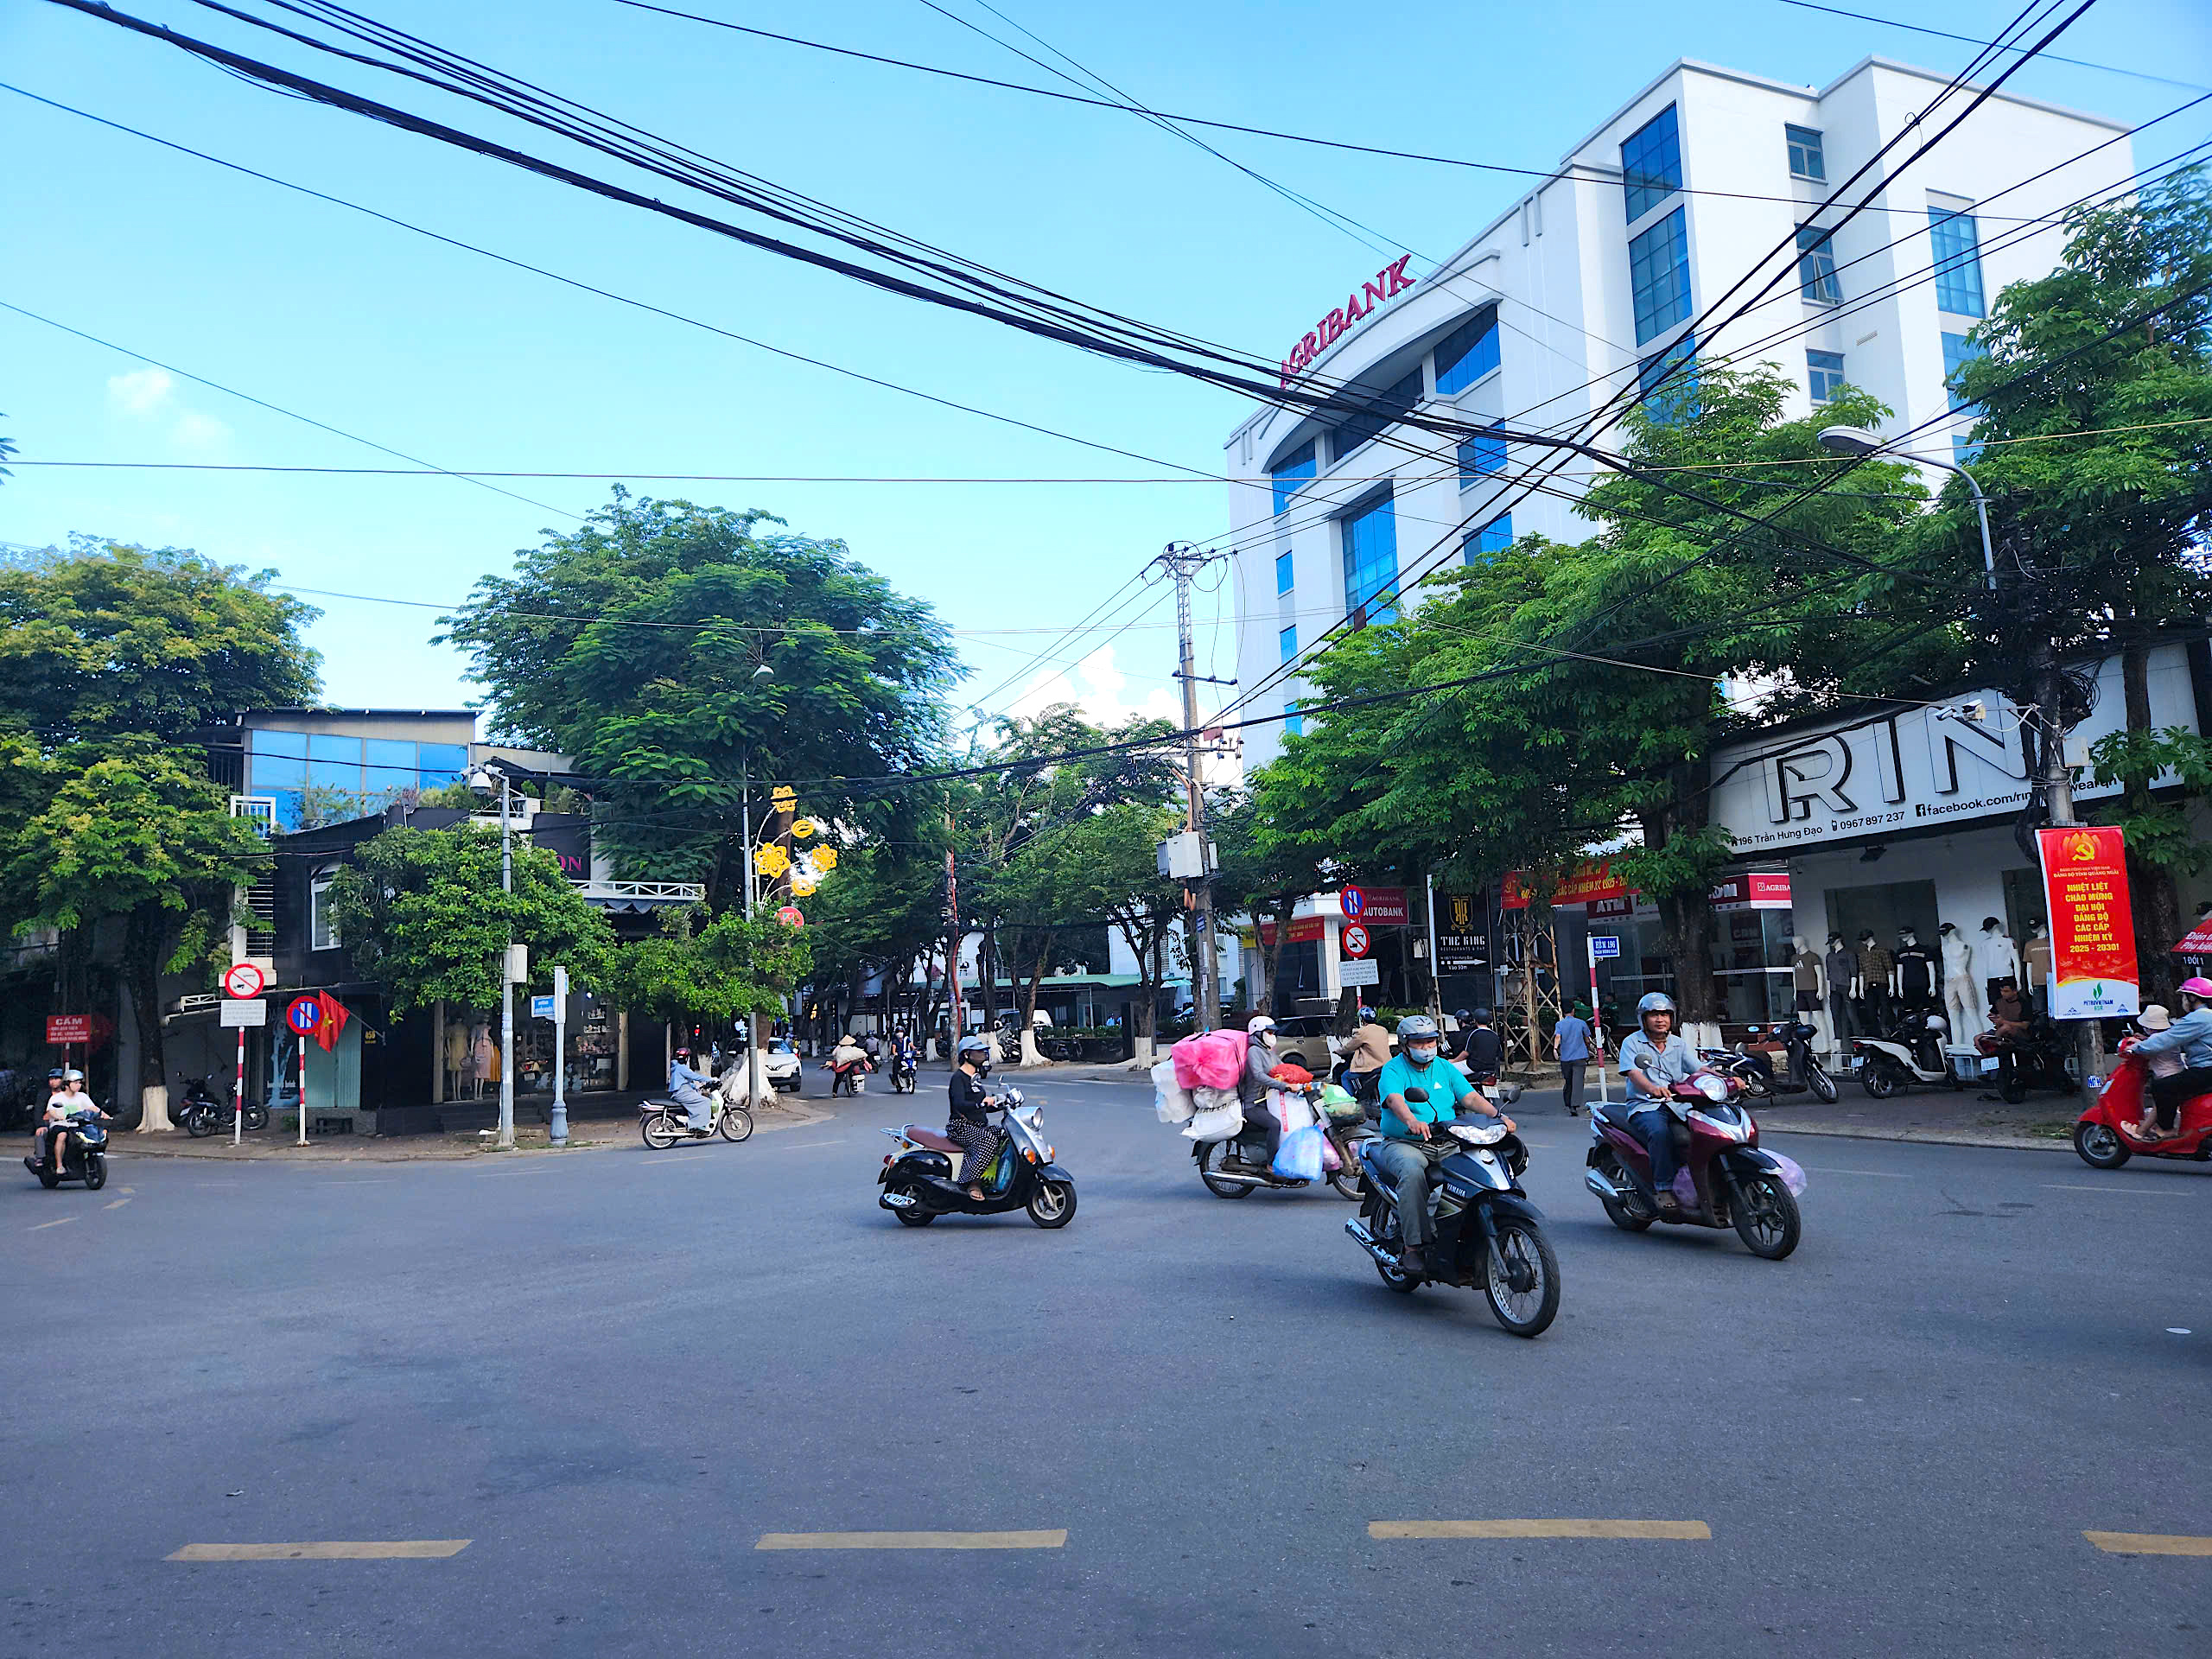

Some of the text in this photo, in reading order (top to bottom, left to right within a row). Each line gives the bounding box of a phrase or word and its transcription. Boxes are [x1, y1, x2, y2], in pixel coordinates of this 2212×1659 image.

[1281, 253, 1416, 390] AGRIBANK
[1762, 690, 2029, 822] RIN
[1840, 811, 1905, 830] 0967 897 237
[1738, 826, 1823, 846] 196 Trần Hưng Đạo
[2067, 881, 2108, 893] NHIỆT LIỆT
[2065, 892, 2113, 902] CHÀO MỪNG
[1363, 907, 1404, 917] AUTOBANK
[2075, 903, 2105, 912] ĐẠI HỘI
[2074, 912, 2109, 922] ĐẢNG BỘ
[2075, 921, 2109, 932] CÁC CẤP
[1440, 936, 1485, 946] THE KING
[2075, 932, 2113, 944] NHIỆM KỲ
[1607, 940, 1616, 949] 196
[2096, 944, 2120, 952] 2030!
[55, 1016, 83, 1026] CẤM
[1446, 1183, 1466, 1198] YAMAHA
